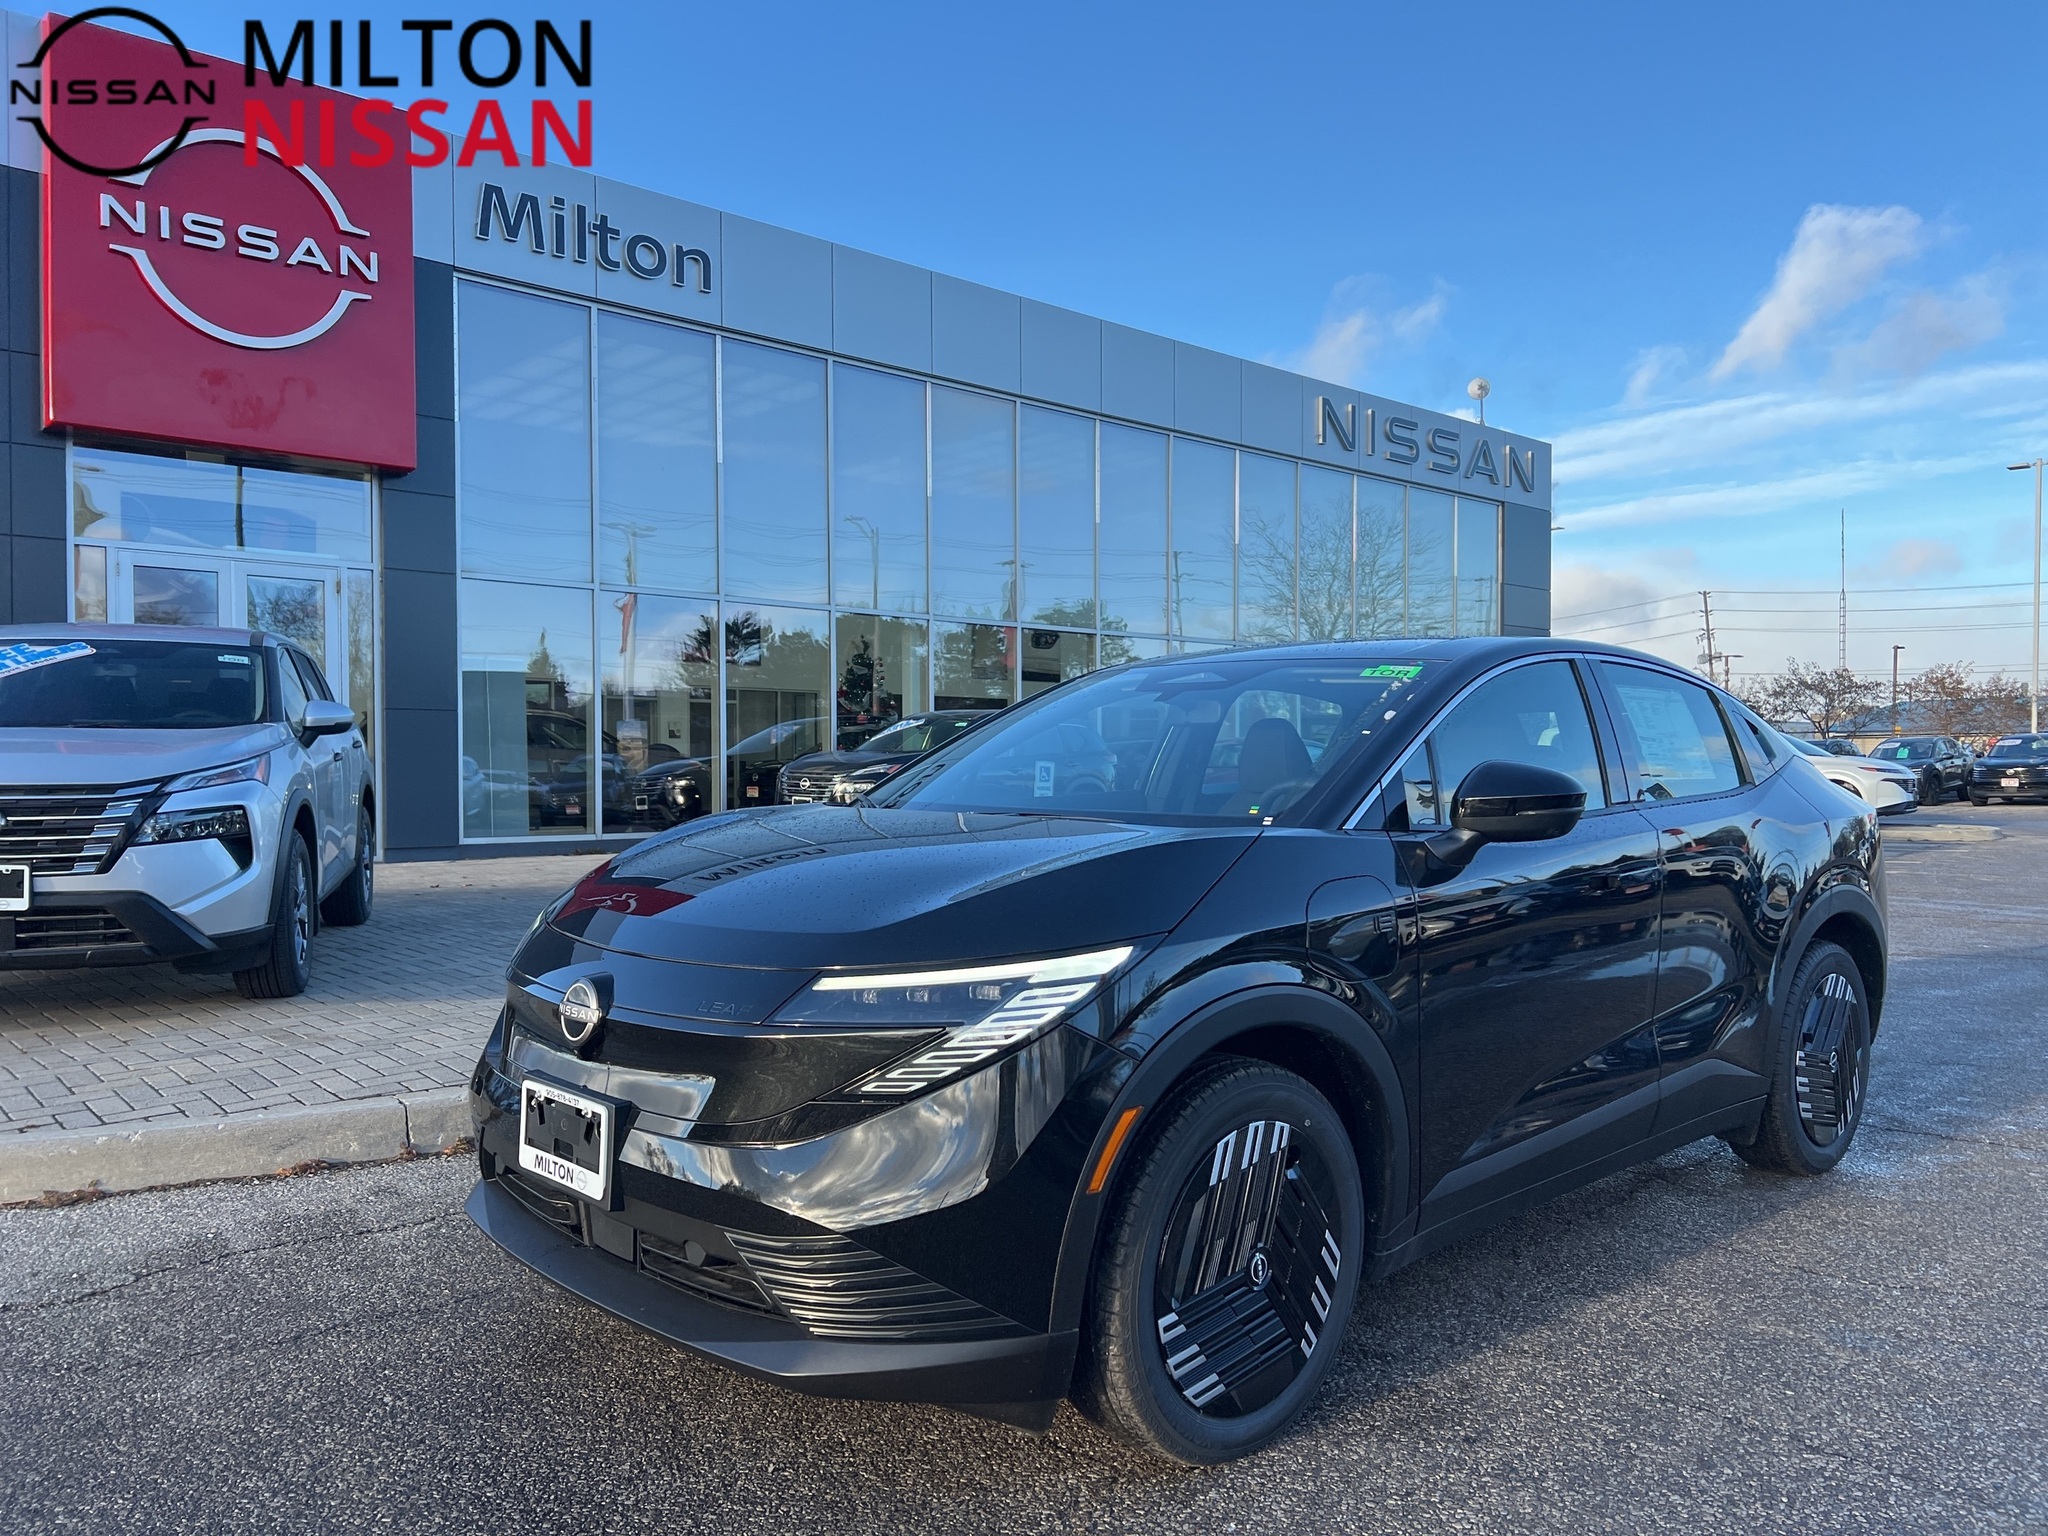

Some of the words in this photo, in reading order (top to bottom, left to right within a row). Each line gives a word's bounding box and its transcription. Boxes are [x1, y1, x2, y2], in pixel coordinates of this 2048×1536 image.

[100, 193, 379, 283] NISSAN
[475, 182, 712, 293] Milton
[1317, 396, 1535, 492] NISSAN
[1369, 669, 1411, 677] TOR
[560, 1002, 598, 1022] NISSAN
[696, 1001, 754, 1017] LEAF
[534, 1154, 574, 1184] MILTON
